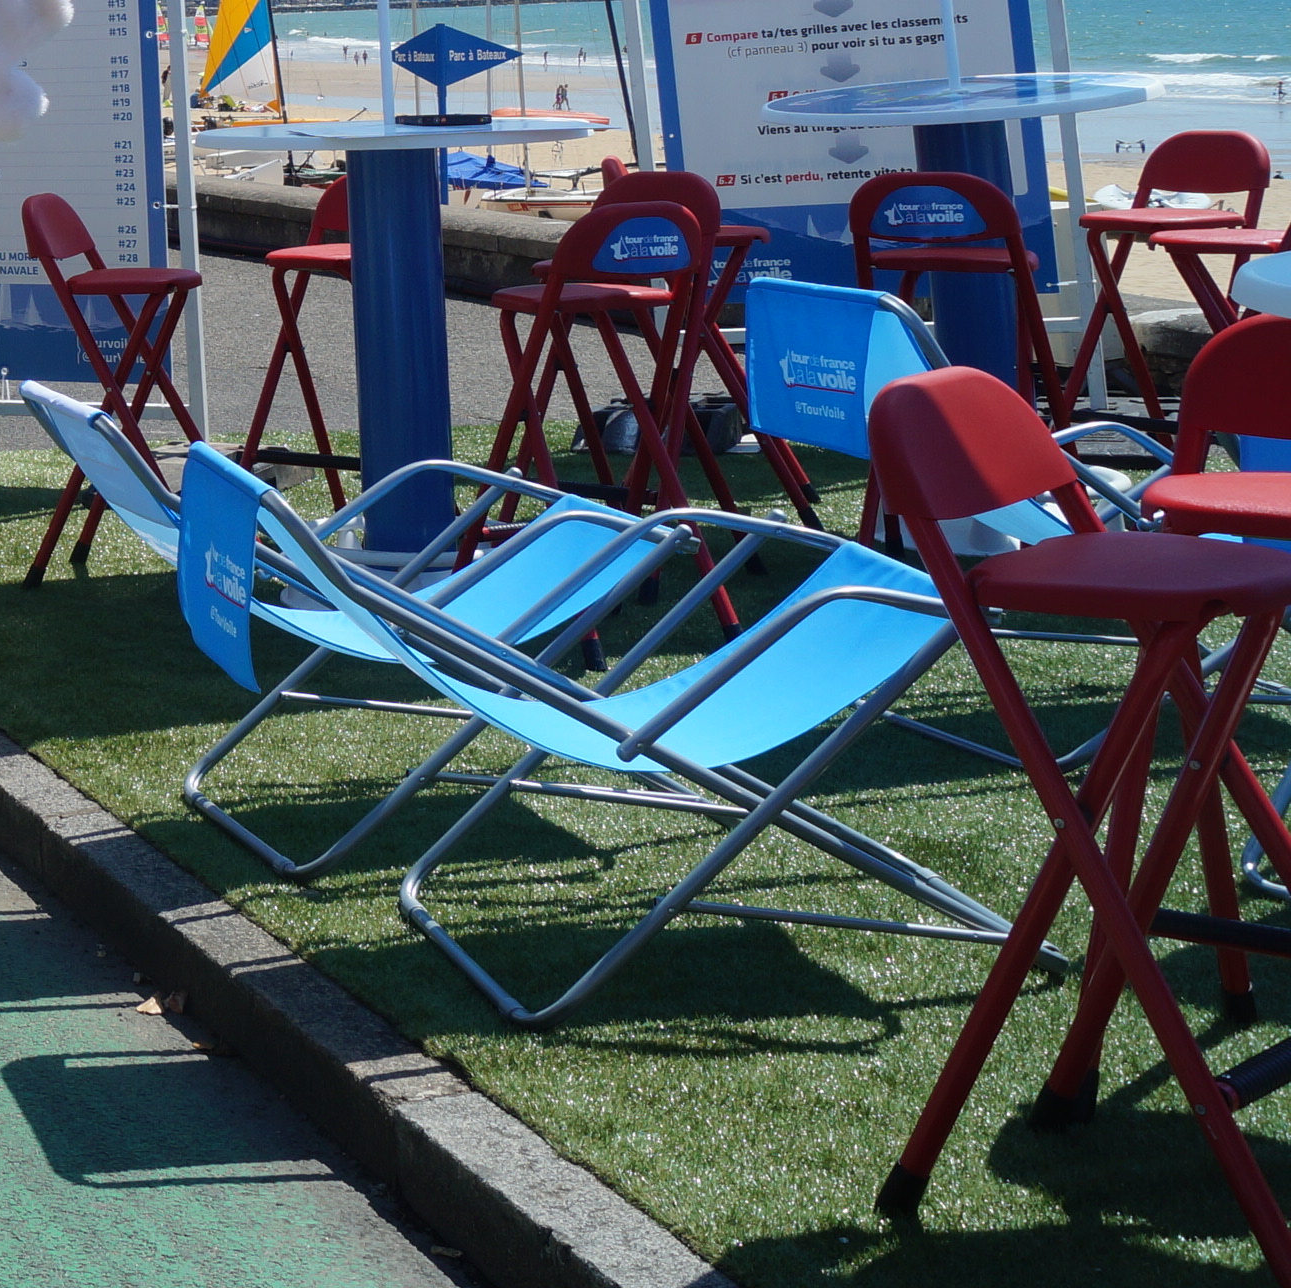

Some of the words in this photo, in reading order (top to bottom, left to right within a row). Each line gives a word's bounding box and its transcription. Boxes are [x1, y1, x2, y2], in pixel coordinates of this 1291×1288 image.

[108, 0, 125, 8] #13
[108, 13, 127, 22] #14
[109, 28, 127, 36] #15
[706, 30, 759, 44] Compare
[761, 27, 798, 39] ta/tes
[801, 23, 838, 38] grilles
[841, 23, 868, 33] avec
[870, 19, 889, 30] les
[891, 15, 968, 28] classemts
[727, 46, 742, 58] (cf
[745, 43, 794, 57] panneau
[811, 39, 839, 53] pour
[842, 37, 866, 48] voir
[869, 36, 879, 46] si
[882, 35, 895, 45] tu
[899, 35, 912, 45] as
[915, 32, 945, 46] gagn
[395, 51, 405, 61] Parc
[414, 51, 434, 62] Bateaux
[449, 50, 465, 61] Parc
[477, 49, 506, 61] Bateaux
[110, 56, 128, 64] #16
[111, 70, 129, 78] #17
[111, 84, 130, 92] #18
[112, 98, 130, 107] #19
[113, 112, 132, 121] #20
[757, 125, 791, 135] Viens
[794, 125, 808, 133] au
[114, 141, 132, 149] #21
[115, 155, 134, 163] #22
[115, 169, 134, 177] #23
[741, 174, 752, 184] Si
[755, 173, 782, 183] c'est
[785, 171, 824, 185] perdu,
[827, 169, 871, 180] retente
[116, 183, 135, 191] #24
[116, 198, 136, 206] #25
[931, 202, 963, 210] france
[927, 211, 964, 222] voile
[118, 226, 137, 234] #26
[118, 240, 137, 248] #27
[649, 243, 678, 256] voile
[119, 254, 138, 262] #28
[753, 258, 791, 267] france
[0, 266, 38, 275] NAVALE
[791, 350, 809, 364] tour
[820, 355, 856, 370] france
[817, 370, 856, 391] voile
[795, 401, 845, 420] @TourVoile
